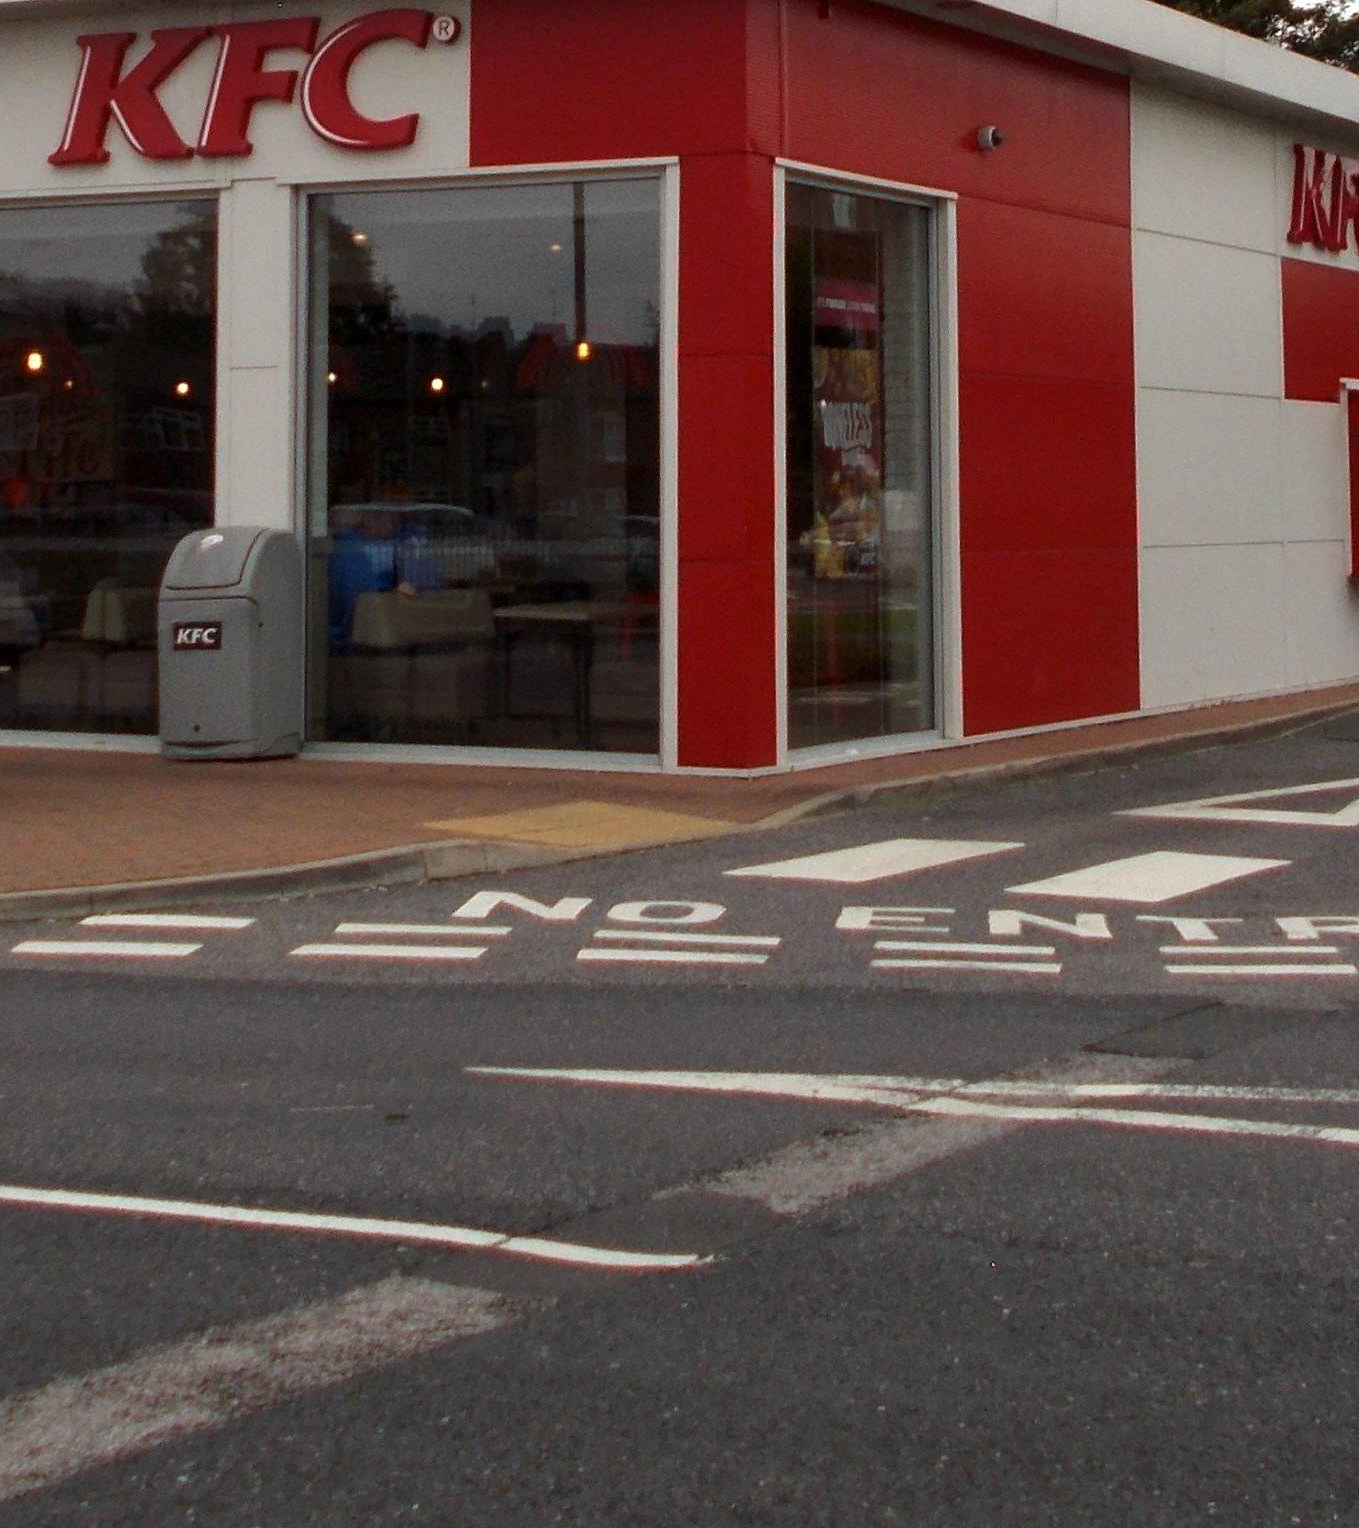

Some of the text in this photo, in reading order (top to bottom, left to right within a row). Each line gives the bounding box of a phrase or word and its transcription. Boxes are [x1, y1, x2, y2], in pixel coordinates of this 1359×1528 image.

[47, 8, 437, 168] KFC
[176, 627, 218, 645] KFC
[451, 890, 727, 923] NO
